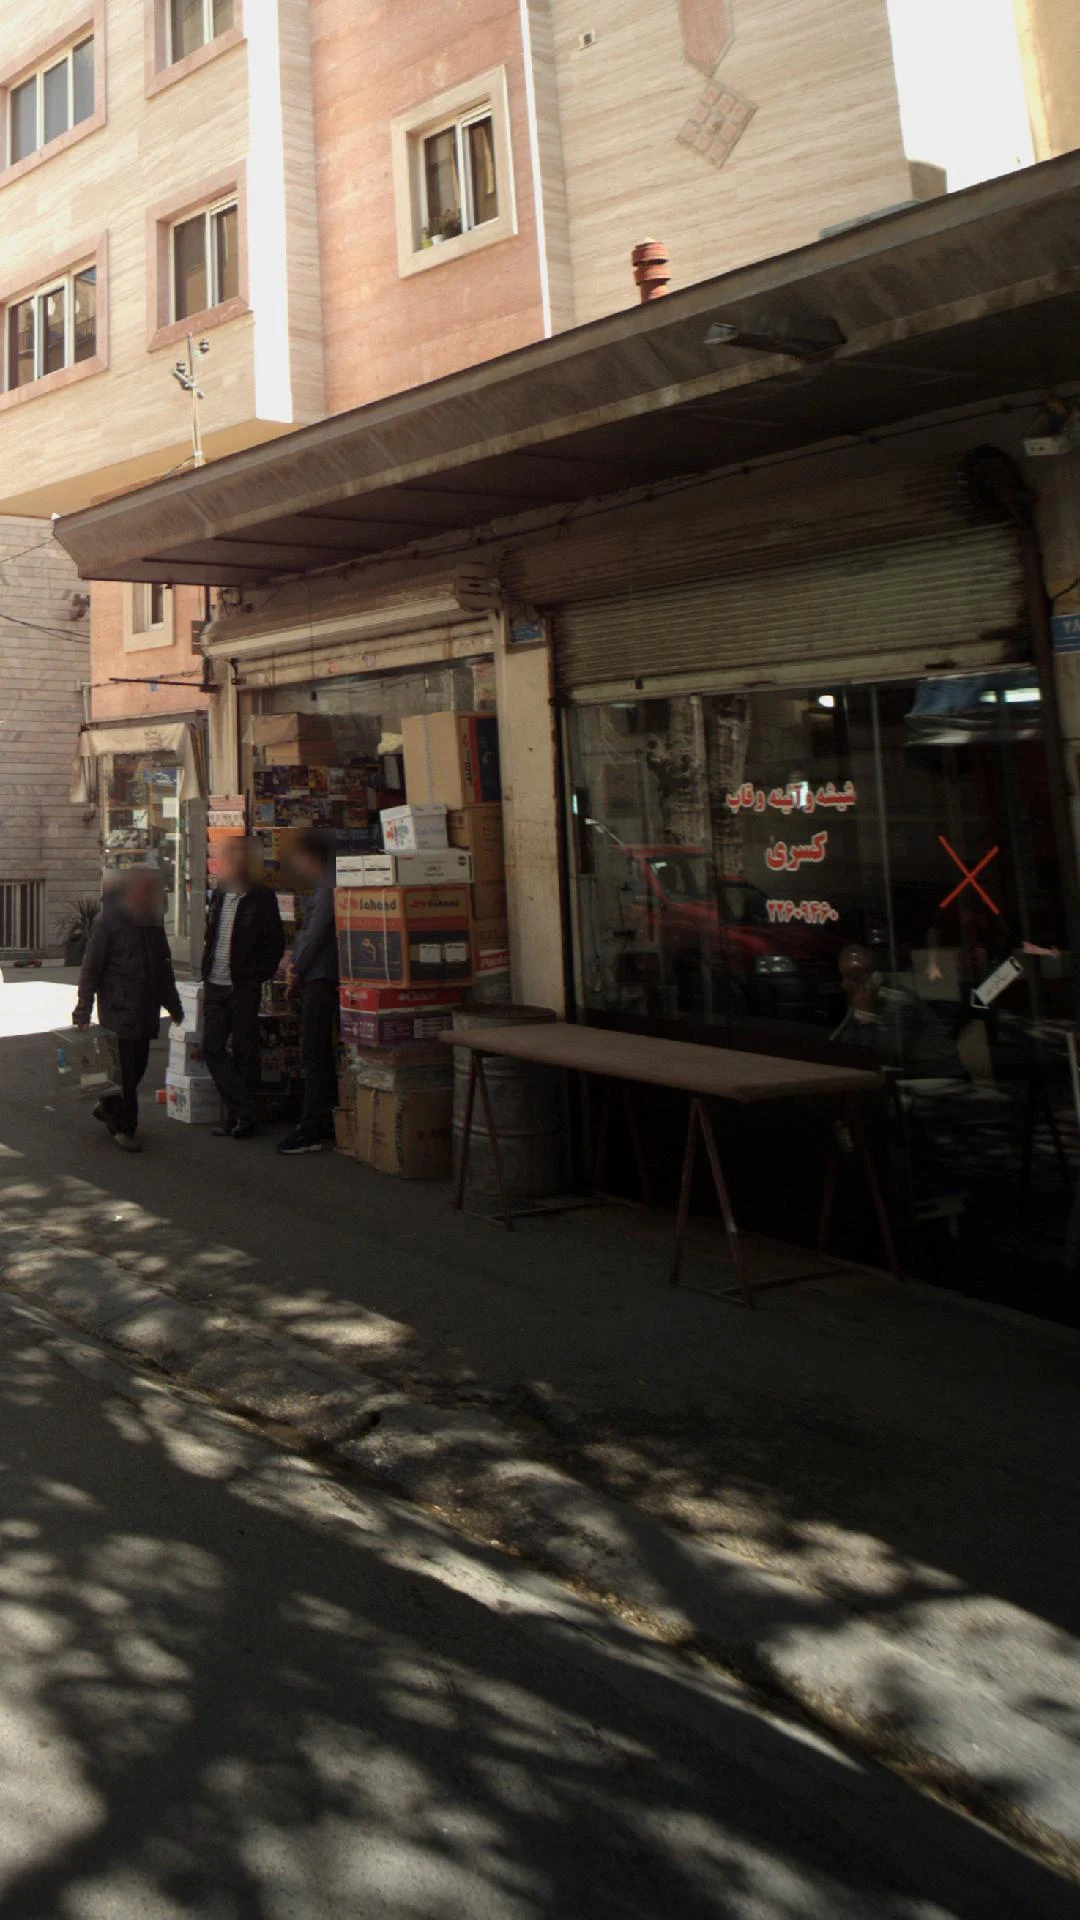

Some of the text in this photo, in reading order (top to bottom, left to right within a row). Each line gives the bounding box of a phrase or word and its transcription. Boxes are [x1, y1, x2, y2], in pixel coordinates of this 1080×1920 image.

[726, 782, 754, 814] قاب
[754, 790, 766, 812] و
[803, 791, 815, 814] و
[815, 780, 857, 811] شیشه
[765, 830, 828, 871] کسری
